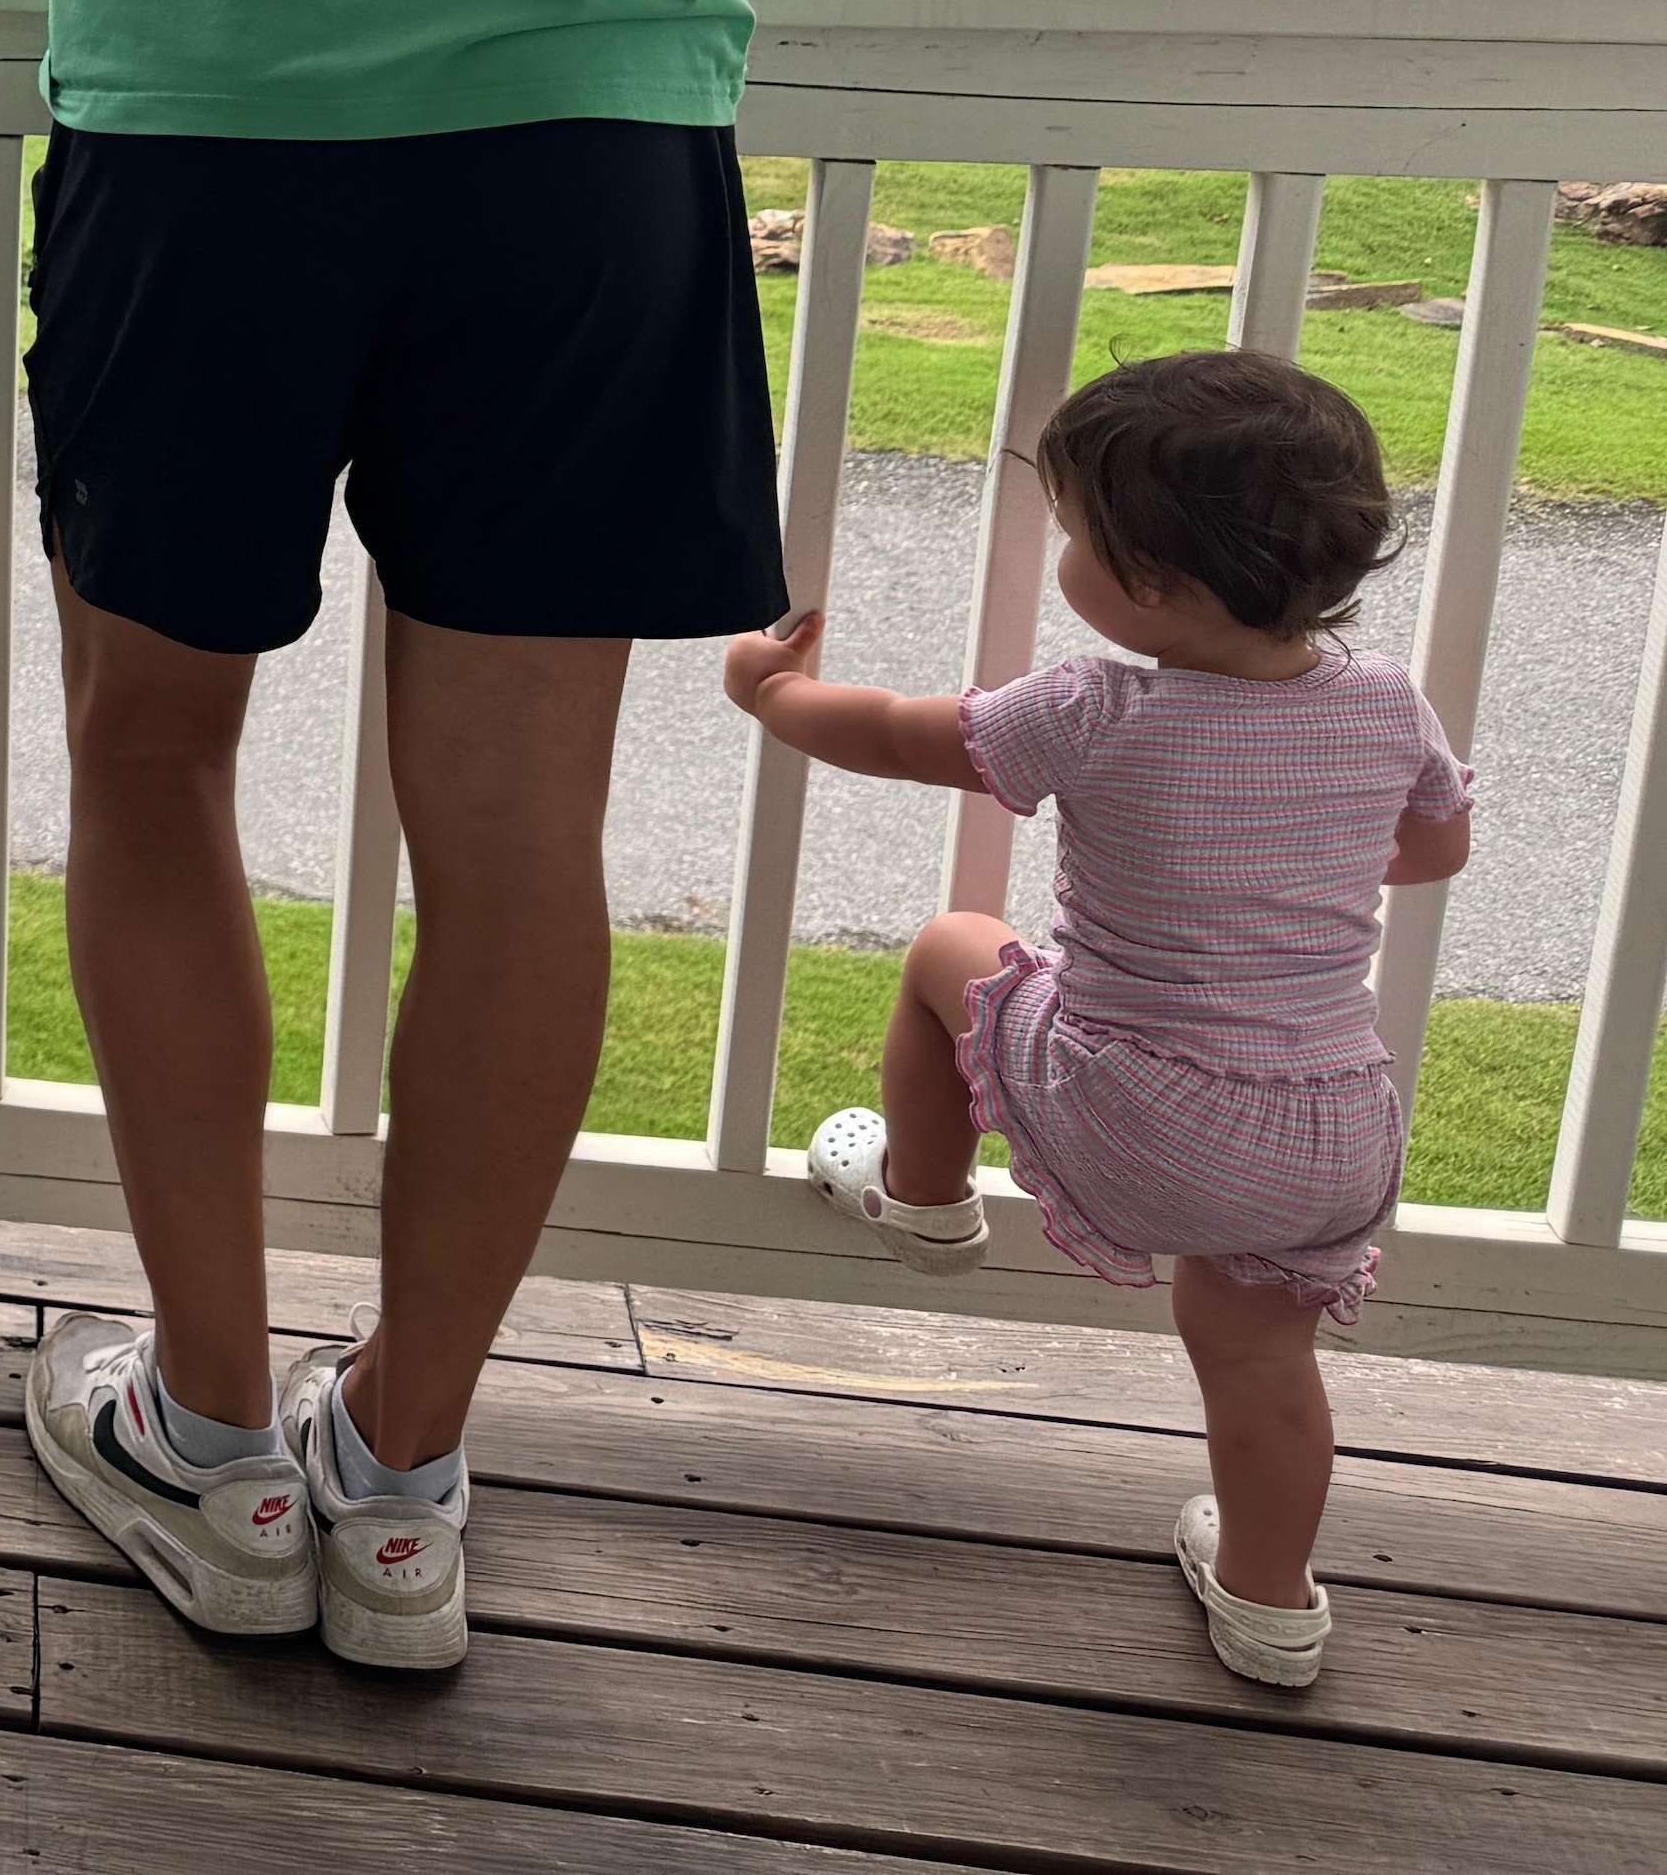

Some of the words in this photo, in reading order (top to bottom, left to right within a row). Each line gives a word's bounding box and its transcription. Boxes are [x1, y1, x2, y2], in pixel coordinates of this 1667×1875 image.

[259, 1494, 292, 1514] NIKE
[384, 1537, 421, 1554] NIKE
[383, 1567, 423, 1579] AIR
